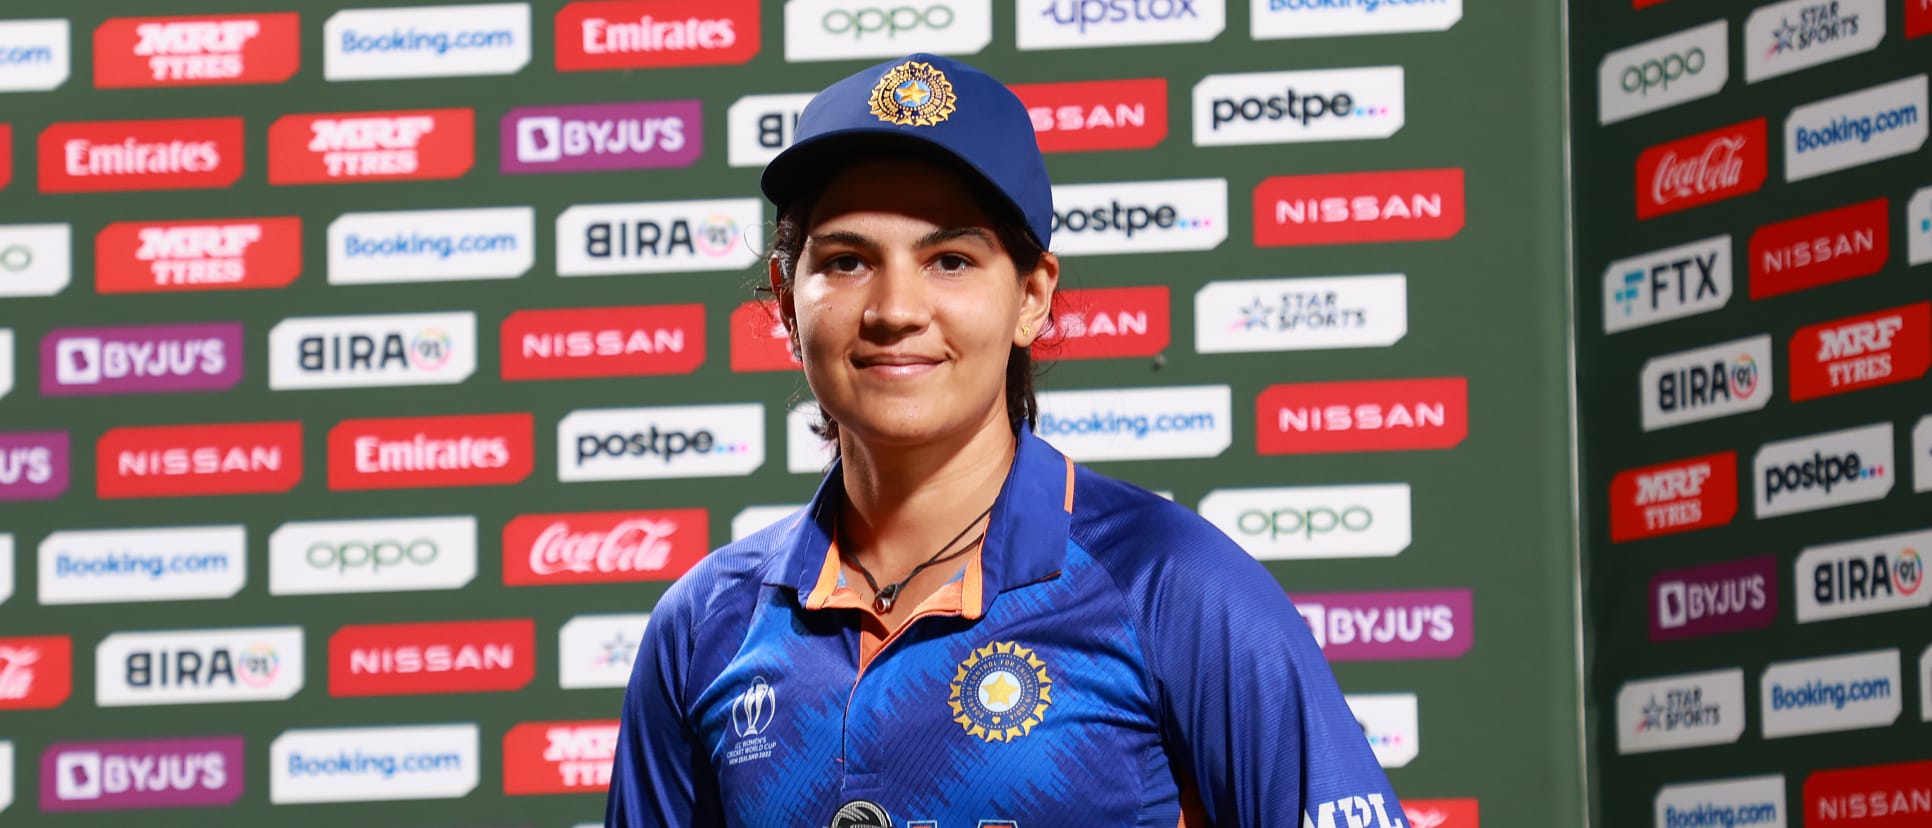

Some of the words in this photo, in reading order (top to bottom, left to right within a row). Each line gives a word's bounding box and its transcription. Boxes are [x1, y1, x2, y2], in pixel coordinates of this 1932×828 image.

[821, 4, 955, 40] oppo
[1801, 1, 1840, 26] STAR
[134, 20, 260, 55] MRF
[341, 30, 514, 55] Booking.com
[582, 15, 736, 54] Emirates
[1799, 16, 1859, 49] SPORTS
[149, 54, 244, 80] TYRES
[1621, 47, 1705, 96] oppo
[309, 115, 434, 152] MRF
[758, 112, 800, 148] BI
[1034, 104, 1144, 133] SSAN
[1796, 104, 1917, 154] Booking.com
[563, 116, 685, 155] BYJU'S
[65, 138, 220, 176] Emirates
[323, 150, 418, 176] TYRES
[1276, 194, 1441, 224] NISSAN
[135, 224, 262, 259] MRF
[345, 233, 517, 259] Booking.com
[1764, 228, 1873, 272] NISSAN
[151, 258, 245, 285] TYRES
[1652, 252, 1718, 310] FTX
[1280, 292, 1337, 309] STAR
[1038, 311, 1147, 338] SAN
[1278, 309, 1366, 331] SPORTS
[523, 329, 684, 357] NISSAN
[1817, 316, 1902, 362] MRF
[102, 338, 226, 378] BYJU'S
[1827, 354, 1892, 388] TYRES
[1040, 408, 1214, 437] Booking.com
[1279, 403, 1444, 432] NISSAN
[119, 446, 281, 475] NISSAN
[355, 434, 509, 472] Emirates
[1635, 464, 1711, 506] MRF
[1237, 505, 1373, 541] oppo
[1644, 499, 1702, 531] TYRES
[56, 552, 228, 579] Booking.com
[306, 539, 439, 574] oppo
[1688, 574, 1765, 619] BYJU'S
[1328, 605, 1454, 644] BYJU'S
[351, 644, 514, 674] NISSAN
[1667, 686, 1702, 708] STAR
[1772, 677, 1890, 711] Booking.com
[1665, 703, 1720, 732] SPORTS
[543, 727, 619, 761] MR
[102, 752, 227, 794] BYJU'S
[288, 752, 462, 779] Booking.com
[1664, 802, 1776, 828] Booking.com
[1818, 789, 1932, 820] NISSAN
